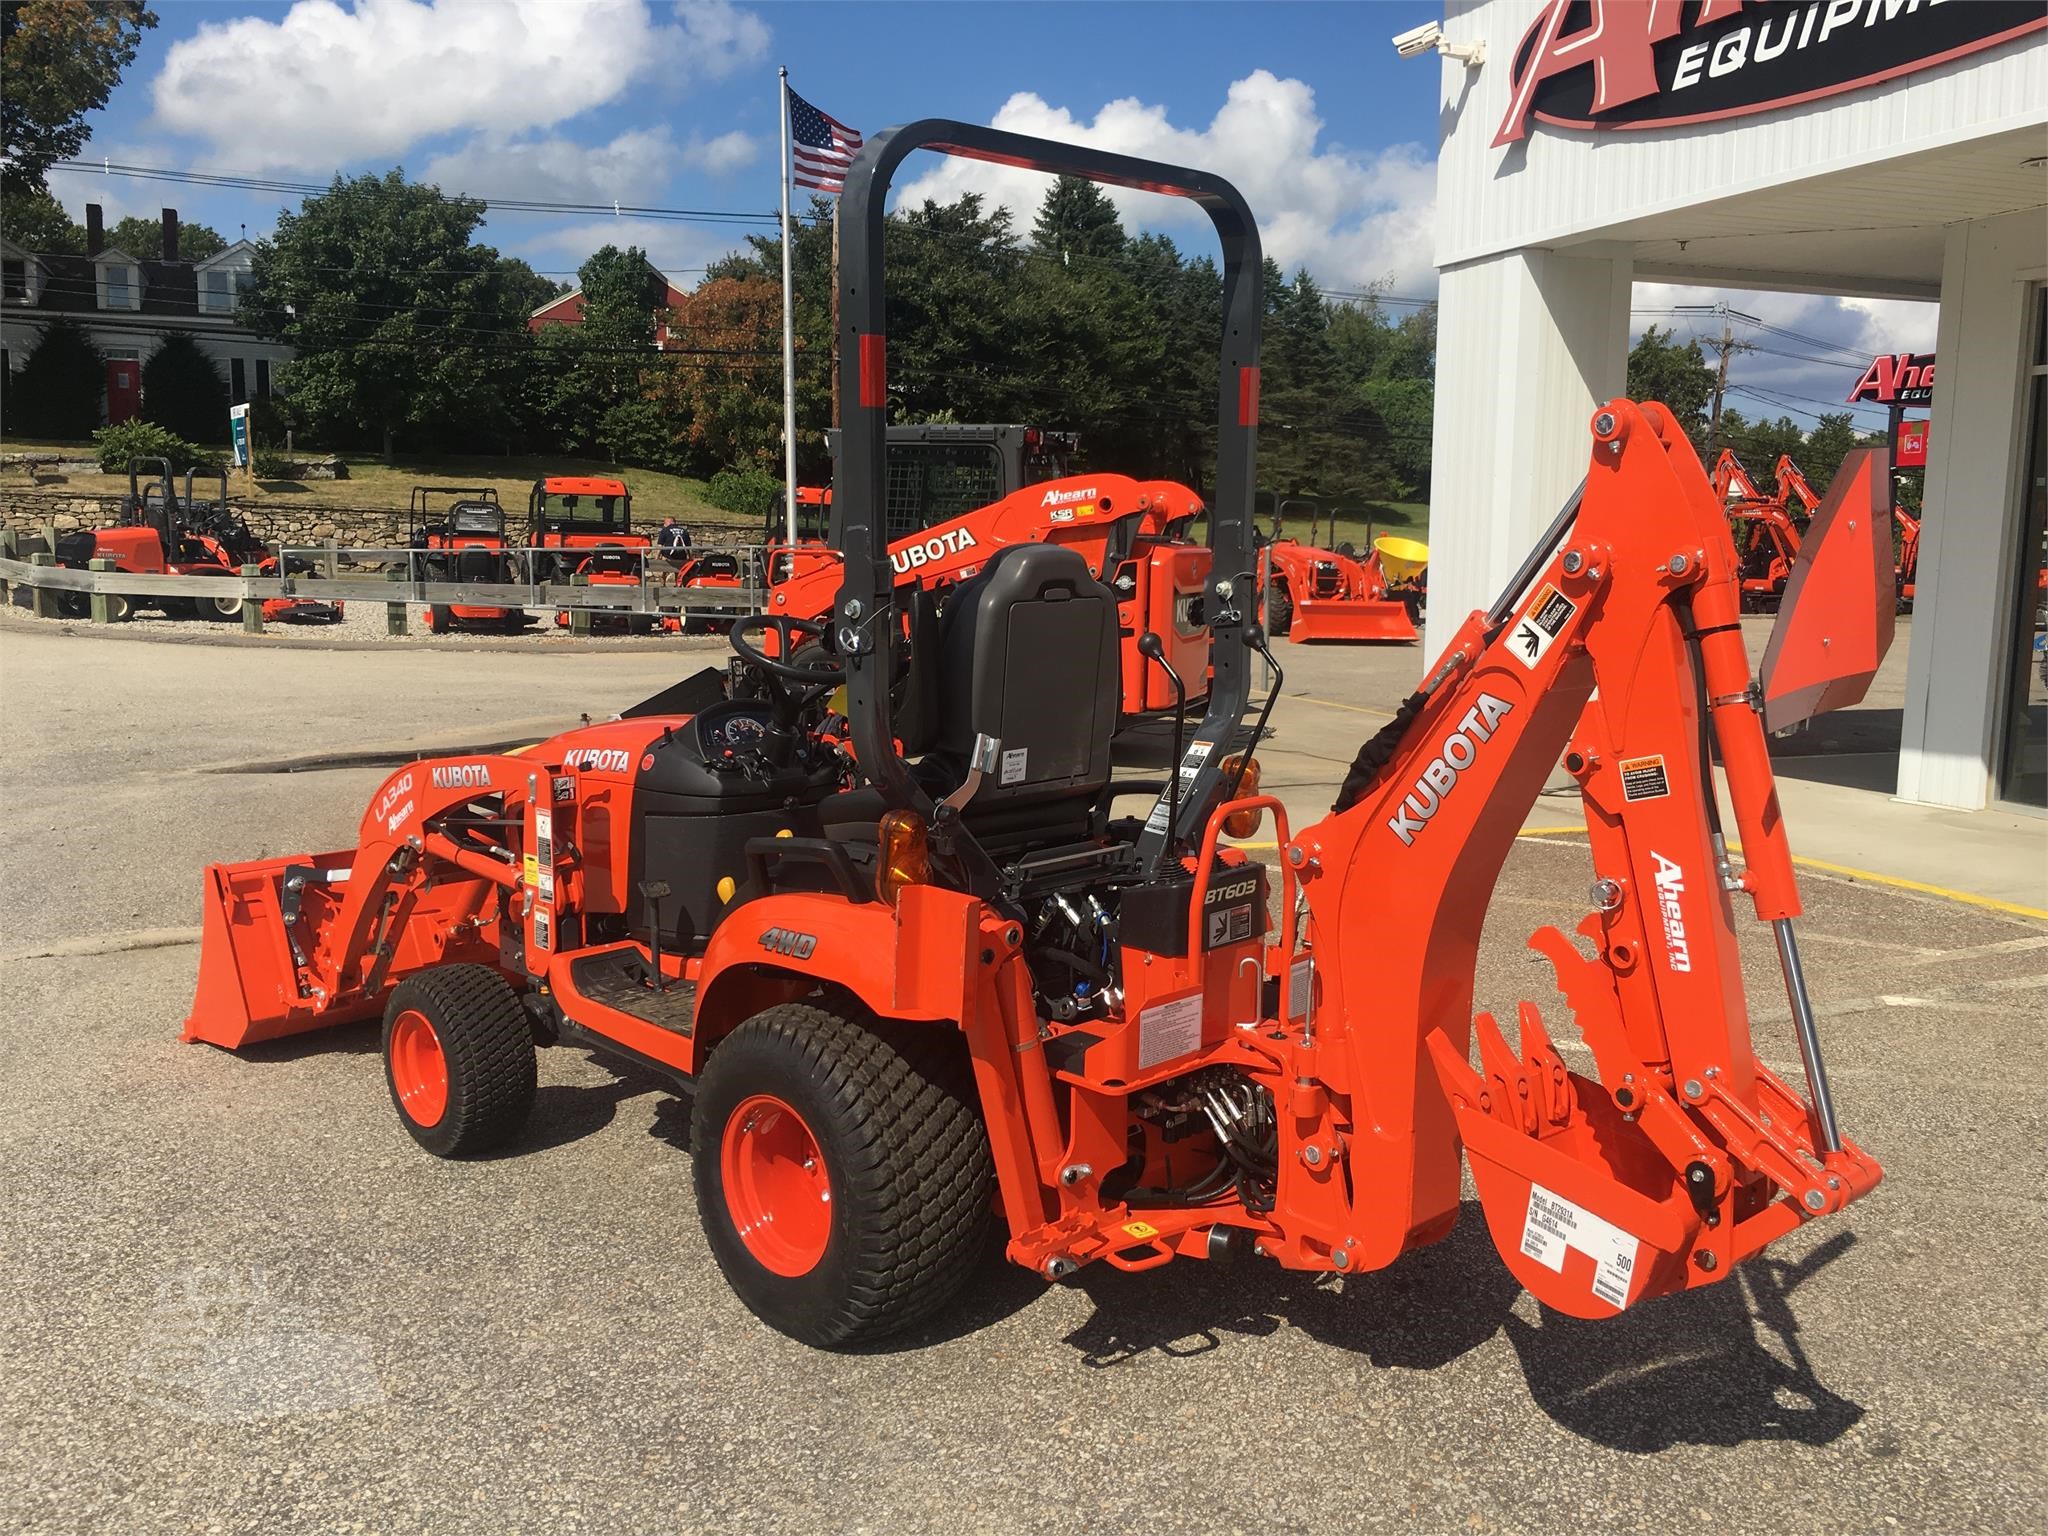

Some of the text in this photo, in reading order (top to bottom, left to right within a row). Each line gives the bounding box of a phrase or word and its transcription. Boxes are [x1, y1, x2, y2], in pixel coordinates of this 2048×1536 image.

[1672, 0, 1949, 92] EQUIPM
[1041, 488, 1097, 507] Ahearn
[890, 527, 977, 576] UBOTA
[432, 765, 491, 788] KUBOTA
[565, 749, 630, 773] KUBOTA
[1387, 692, 1515, 847] KUBOTA
[375, 773, 413, 823] LA340
[387, 800, 414, 836] Ahearn
[1204, 880, 1256, 904] BT603
[1650, 850, 1691, 972] Ahearn
[758, 927, 817, 960] 4WD
[1532, 1191, 1548, 1206] Model
[1616, 1254, 1631, 1272] 500
